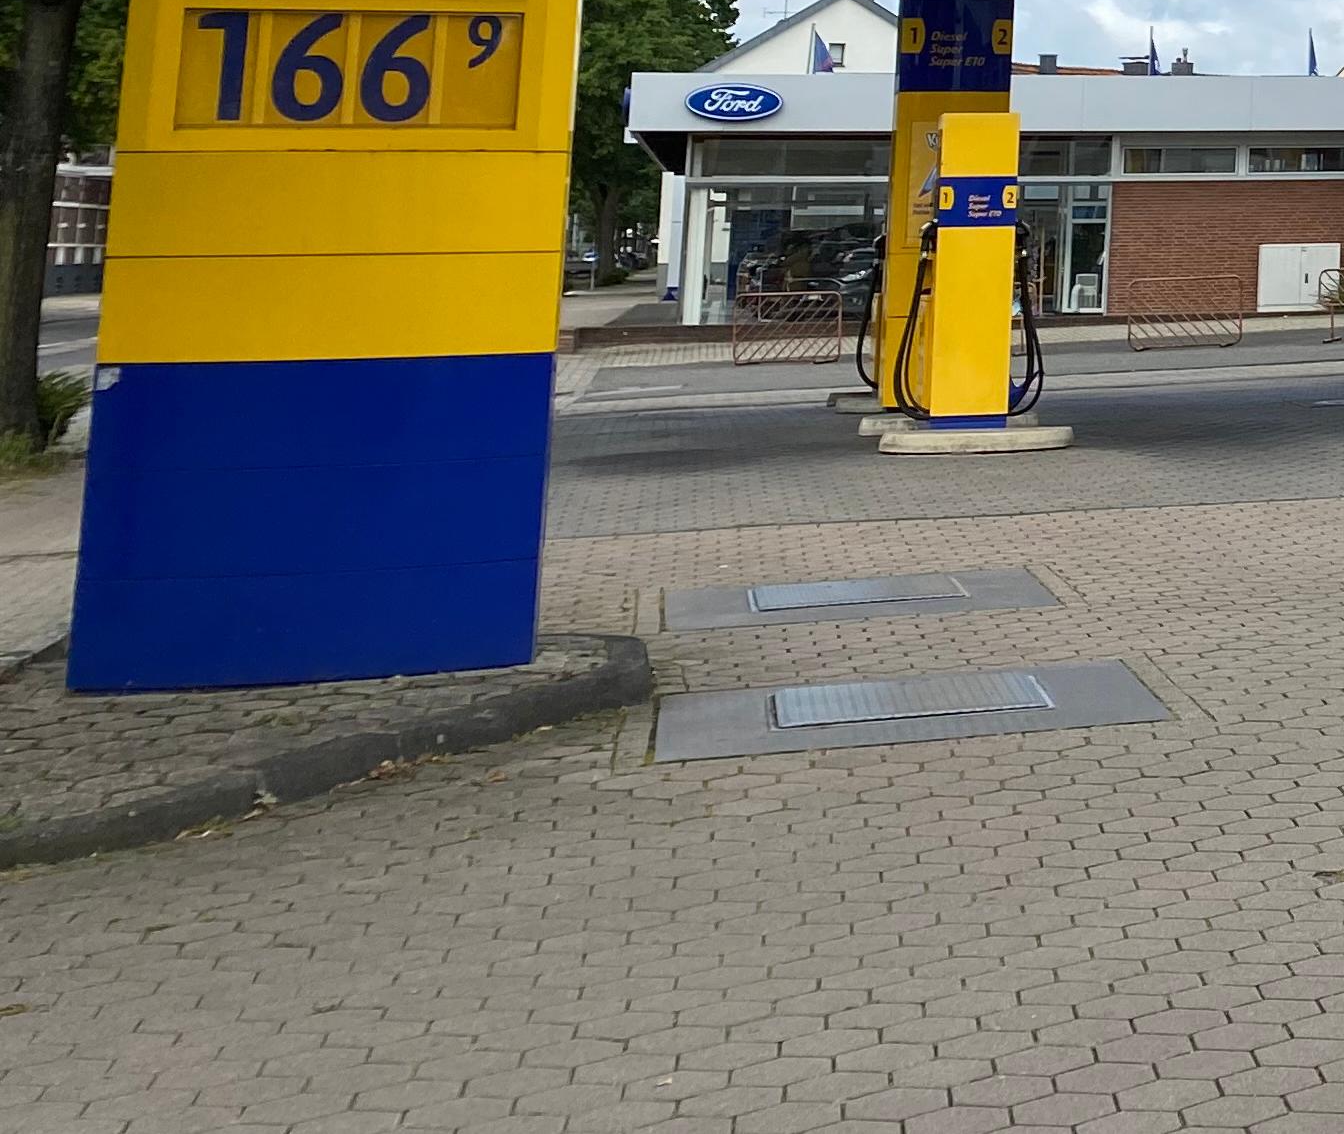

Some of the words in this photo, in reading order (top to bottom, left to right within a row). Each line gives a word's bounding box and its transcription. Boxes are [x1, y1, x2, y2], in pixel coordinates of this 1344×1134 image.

[910, 27, 918, 44] 1
[930, 31, 969, 42] Diesel
[997, 29, 1008, 45] 2
[930, 44, 964, 56] Super
[198, 10, 432, 122] 166
[467, 15, 503, 68] 9
[928, 56, 964, 69] Super
[964, 56, 986, 67] E10
[703, 88, 764, 112] Ford
[943, 191, 949, 204] 1
[1006, 191, 1015, 204] 2
